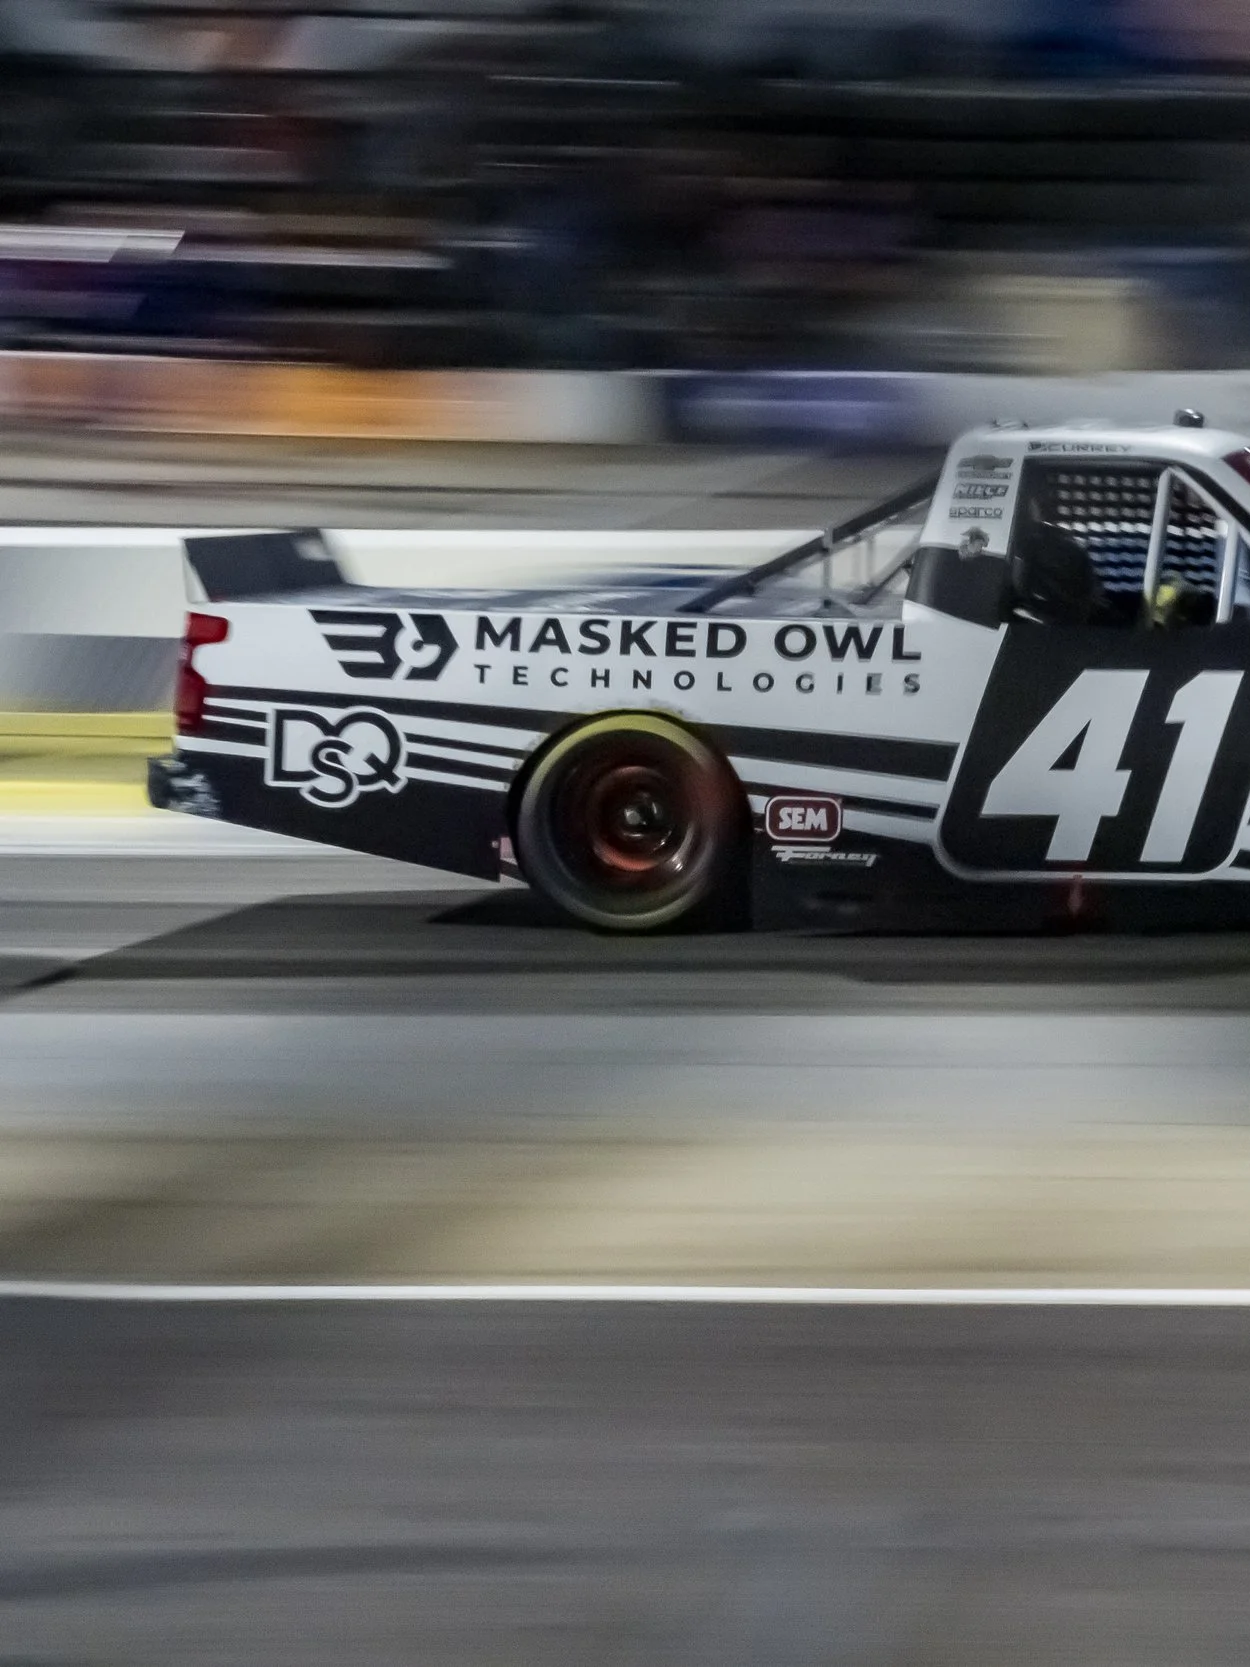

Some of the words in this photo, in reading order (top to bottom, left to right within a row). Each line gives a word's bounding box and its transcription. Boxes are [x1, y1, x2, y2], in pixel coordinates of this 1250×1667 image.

[949, 506, 1003, 518] sparco
[474, 615, 748, 659] MASKED
[774, 622, 922, 664] OWL
[474, 663, 922, 696] TECHNOLOGIES
[980, 668, 1245, 863] 41
[778, 806, 828, 832] SEM
